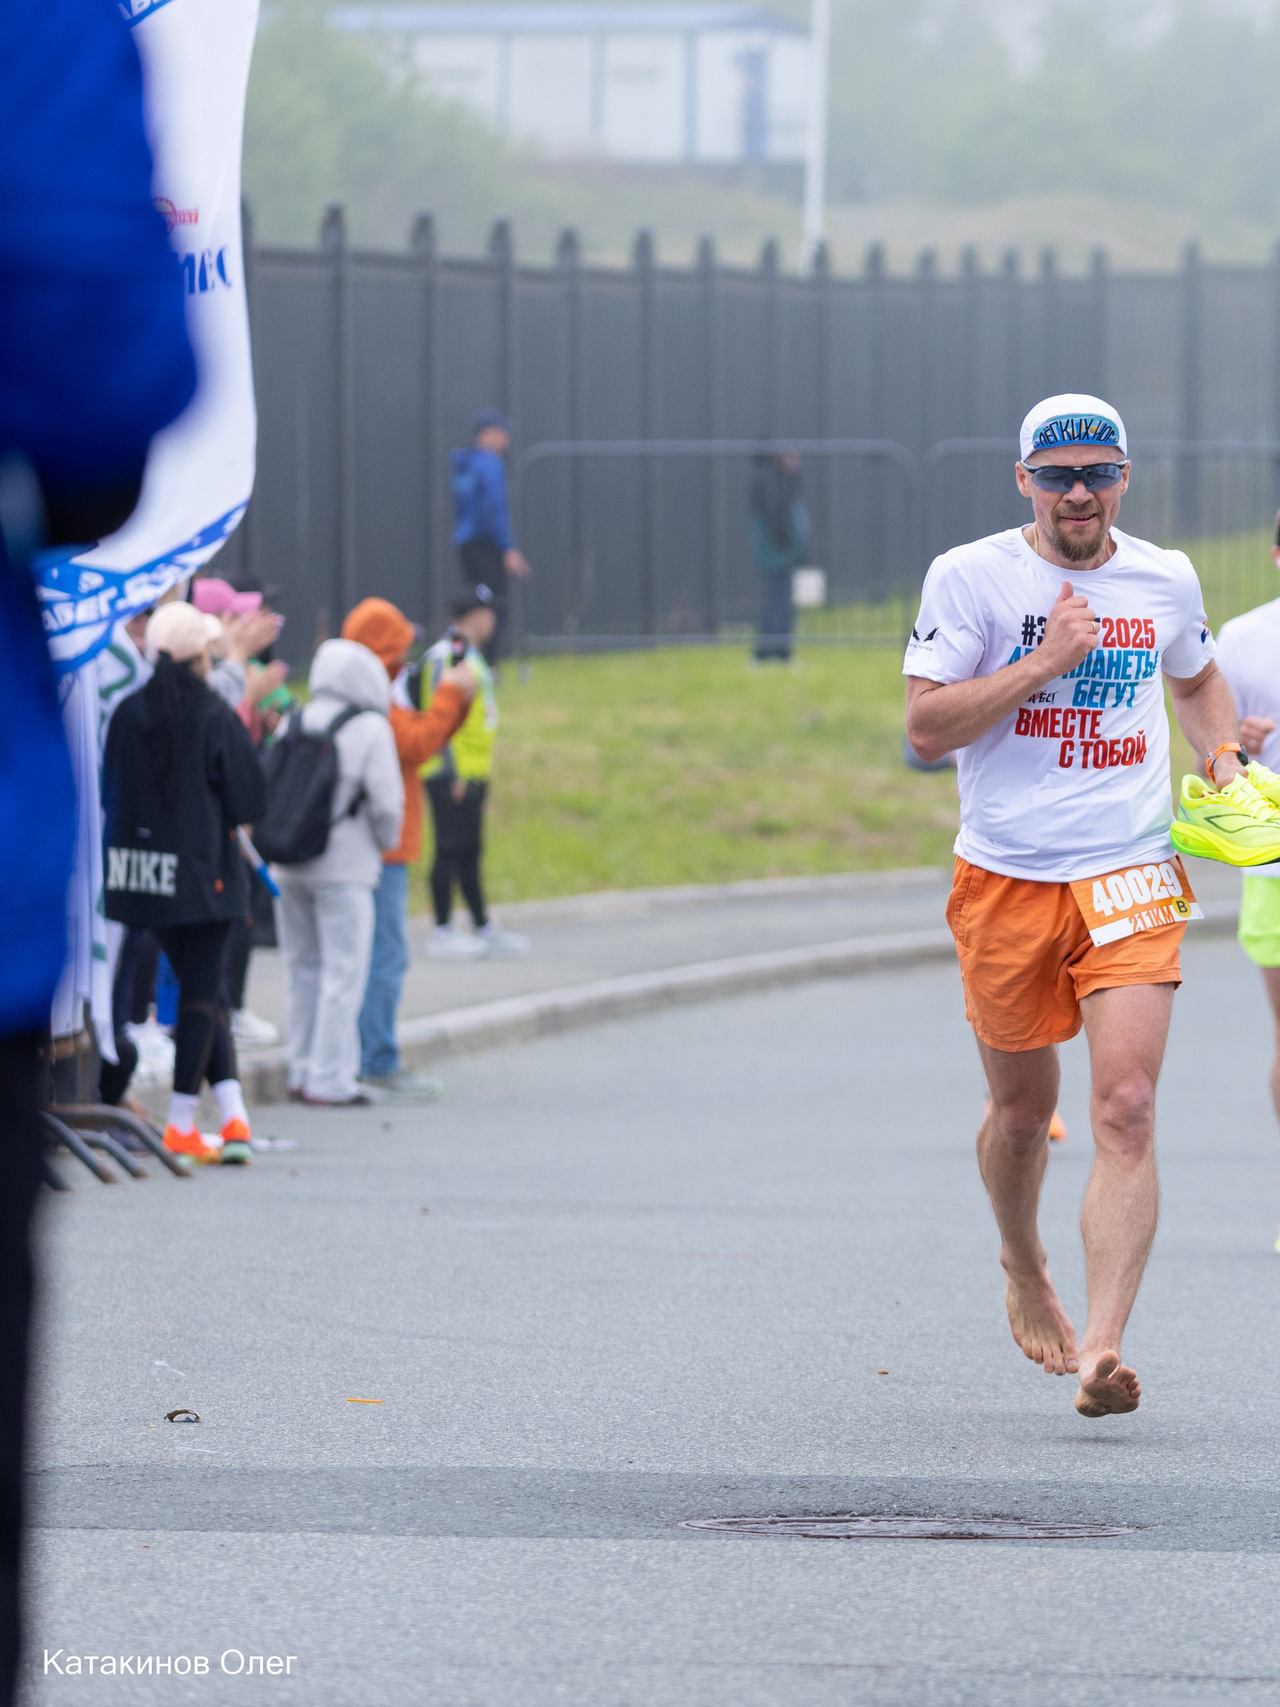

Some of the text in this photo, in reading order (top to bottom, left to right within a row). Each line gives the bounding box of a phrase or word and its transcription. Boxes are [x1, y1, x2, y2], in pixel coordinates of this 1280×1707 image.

[1021, 614, 1156, 649] #З2025
[1072, 679, 1140, 708] БЕГУТ
[1015, 707, 1103, 739] ВМЕСТЕ
[1059, 730, 1147, 769] С ТОБОЙ
[107, 847, 178, 897] NIKE
[1092, 862, 1183, 917] 40029
